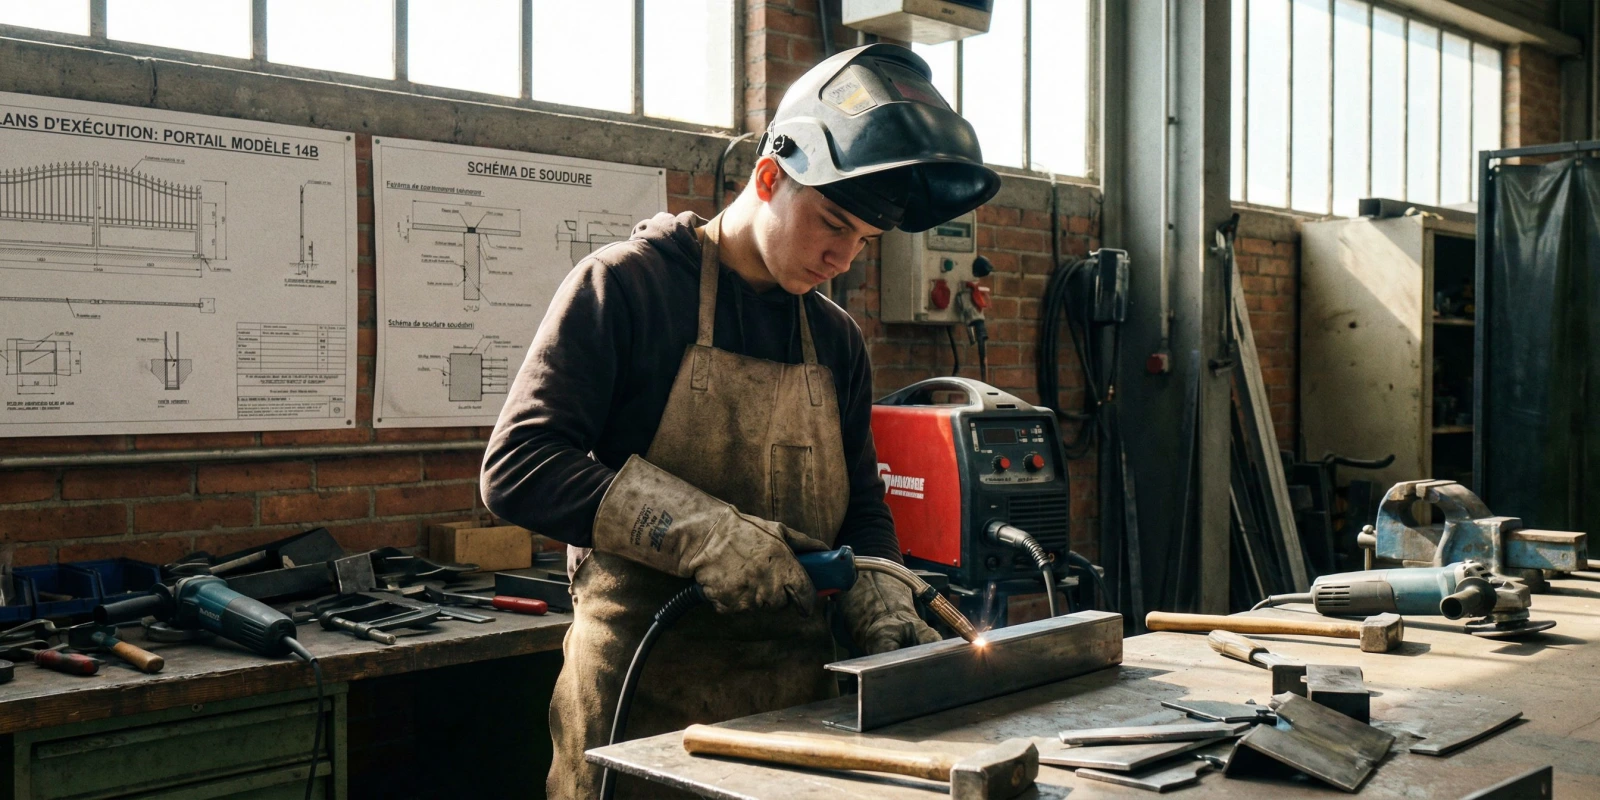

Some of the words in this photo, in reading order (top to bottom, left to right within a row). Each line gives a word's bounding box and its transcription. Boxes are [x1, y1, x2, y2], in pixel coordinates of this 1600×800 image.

[0, 112, 39, 129] ANS
[44, 116, 158, 141] D'EXÉCUTION:
[163, 129, 227, 149] PORTAIL
[231, 137, 291, 155] MODÈLE
[295, 144, 319, 158] 14B
[467, 161, 518, 177] SCHÉMA
[520, 167, 536, 179] DE
[539, 169, 593, 185] SOUDURE
